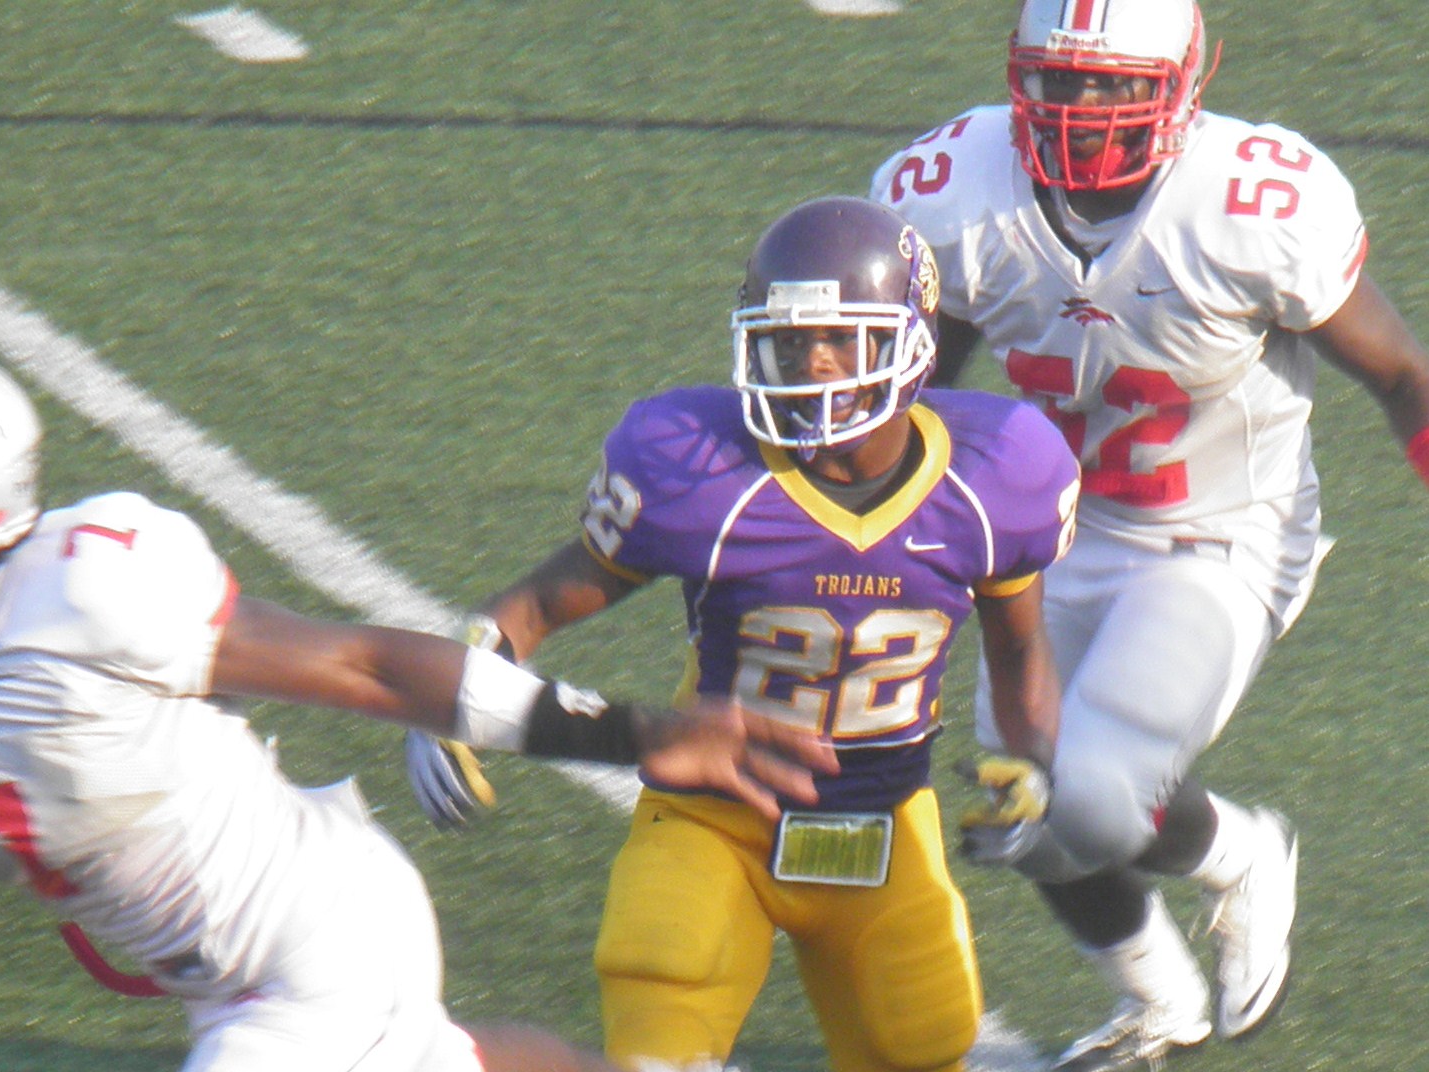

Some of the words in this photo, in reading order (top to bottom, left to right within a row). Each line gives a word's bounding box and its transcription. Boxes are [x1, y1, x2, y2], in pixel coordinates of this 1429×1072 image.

[1225, 135, 1313, 220] 52
[1006, 347, 1191, 509] 52
[815, 574, 901, 597] TROJANS
[733, 606, 952, 738] 22
